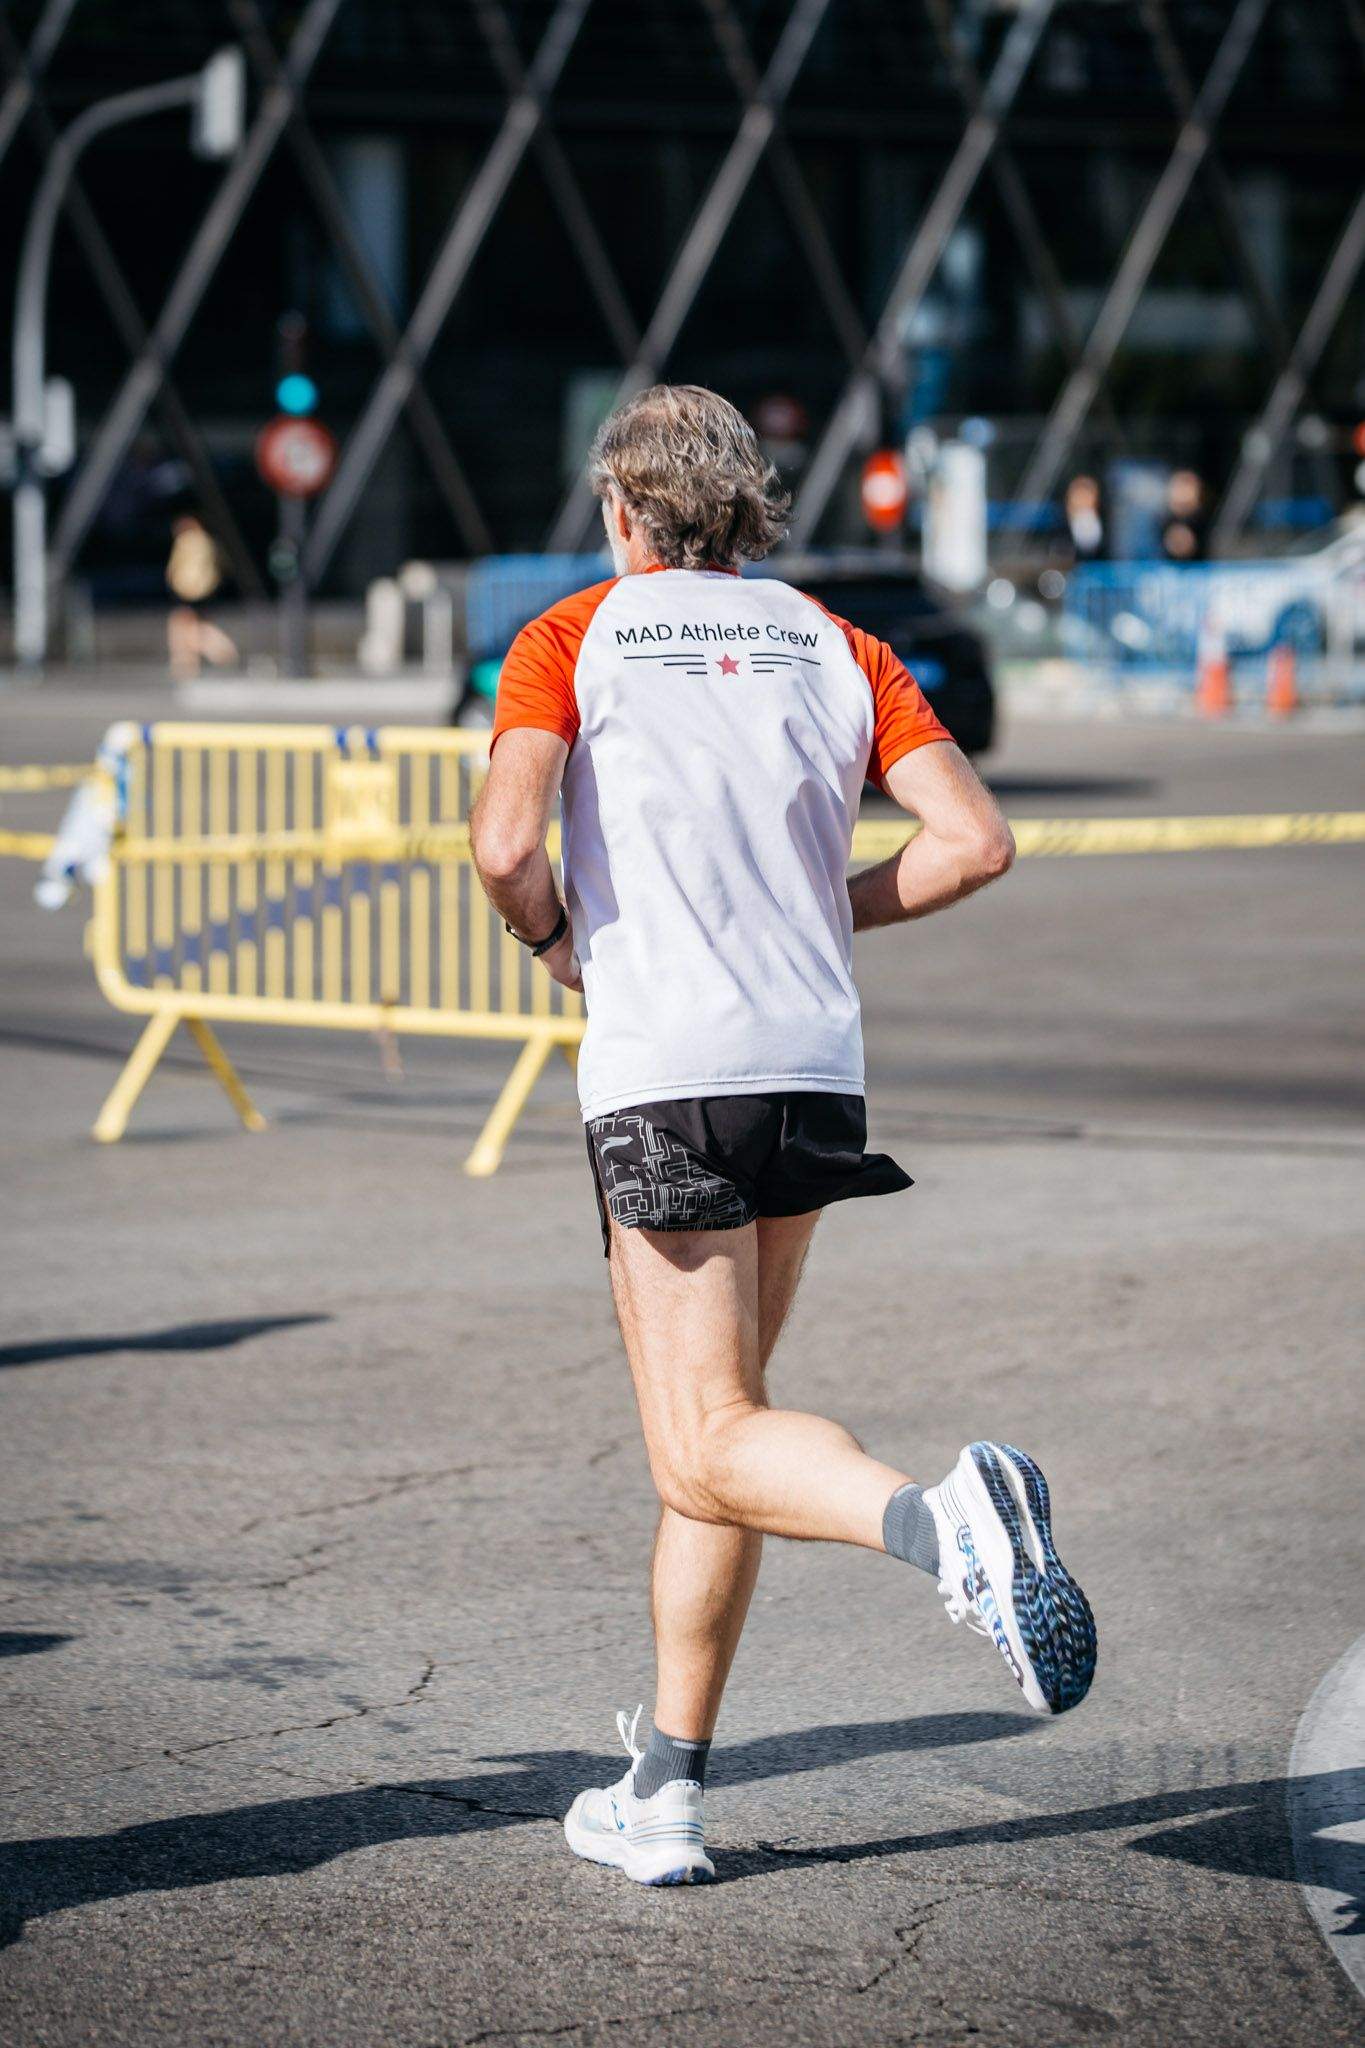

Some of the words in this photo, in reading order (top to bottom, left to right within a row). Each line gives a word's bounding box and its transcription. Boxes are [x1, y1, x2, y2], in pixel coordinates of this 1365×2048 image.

[615, 624, 673, 645] MAD
[680, 623, 760, 641] Athlete
[766, 624, 818, 648] Crew
